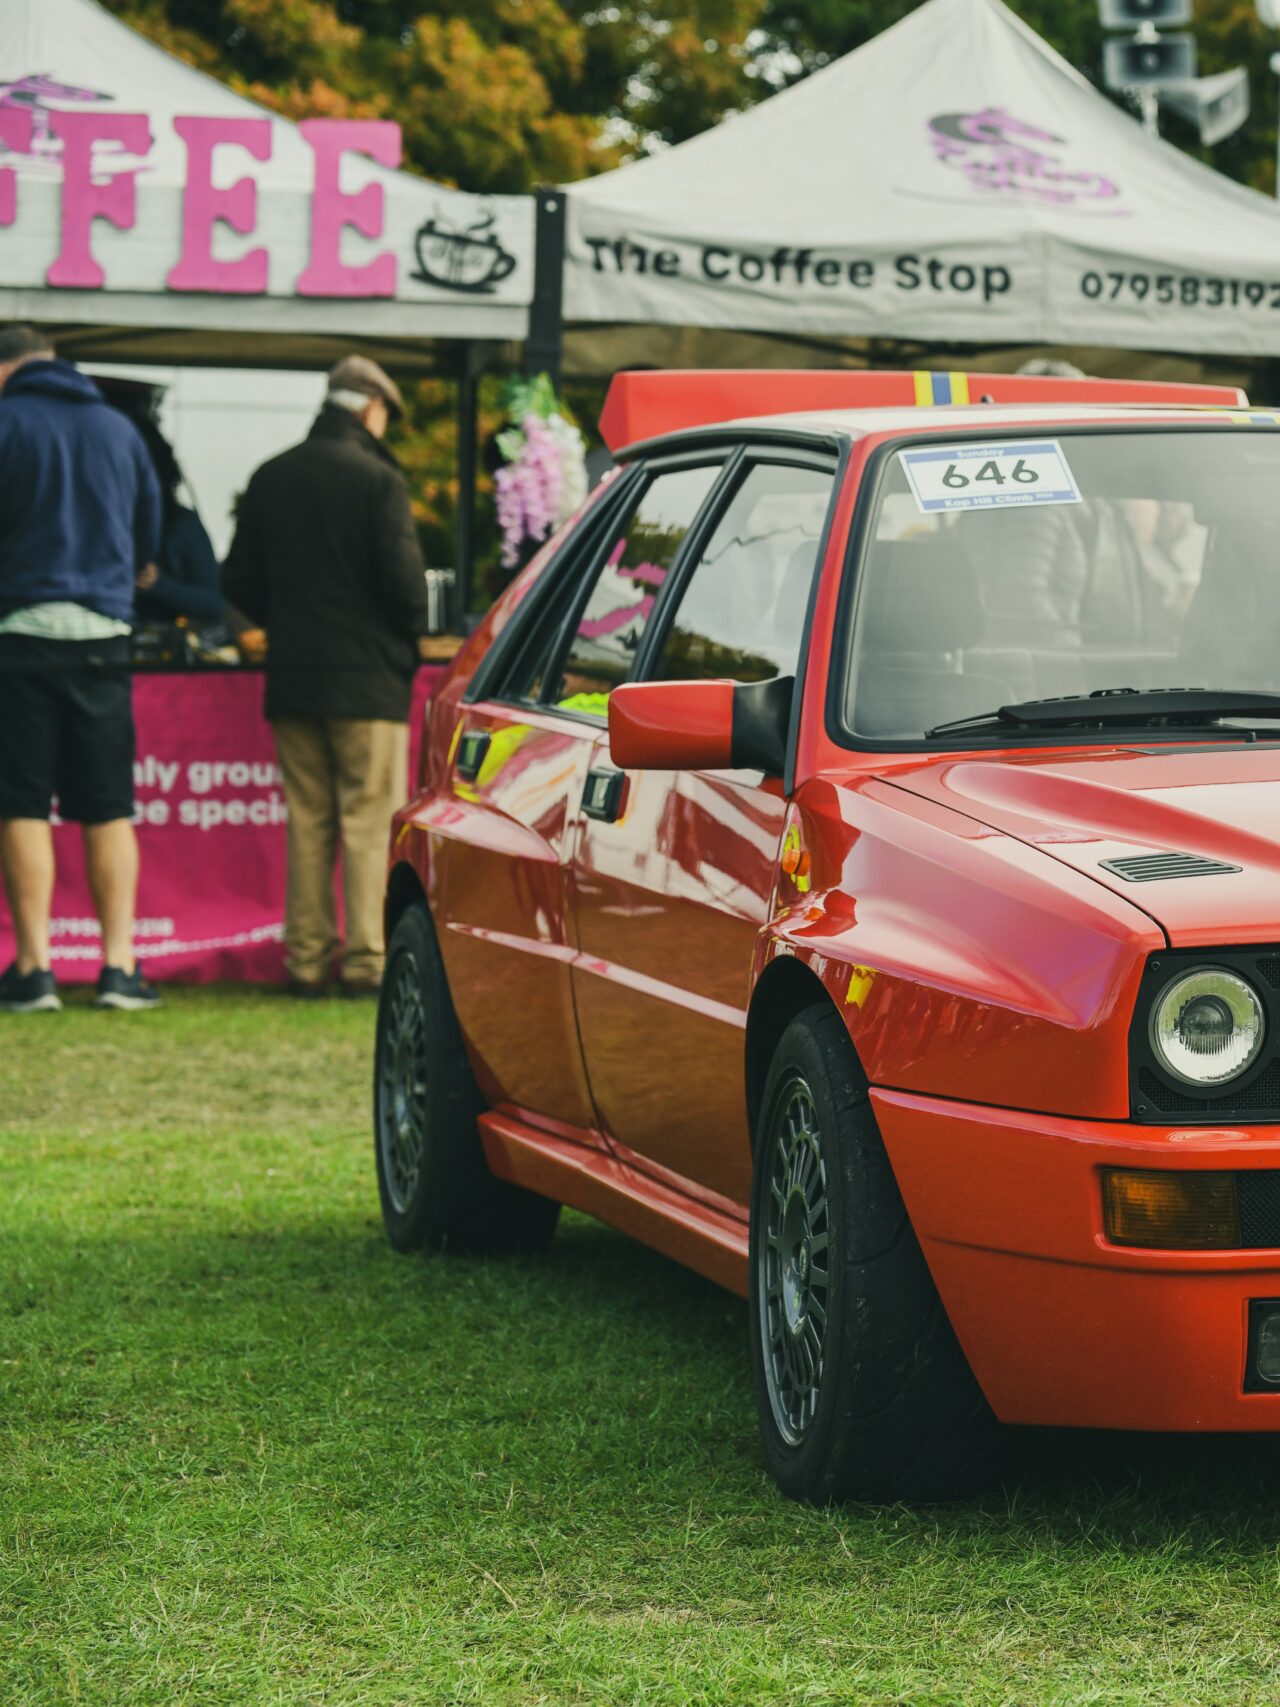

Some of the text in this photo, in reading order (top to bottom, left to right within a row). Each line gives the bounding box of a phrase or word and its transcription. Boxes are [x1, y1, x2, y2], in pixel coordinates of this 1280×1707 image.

[584, 236, 1012, 301] The Coffee Stop
[956, 448, 1005, 459] Sunday
[942, 459, 1039, 488] 646
